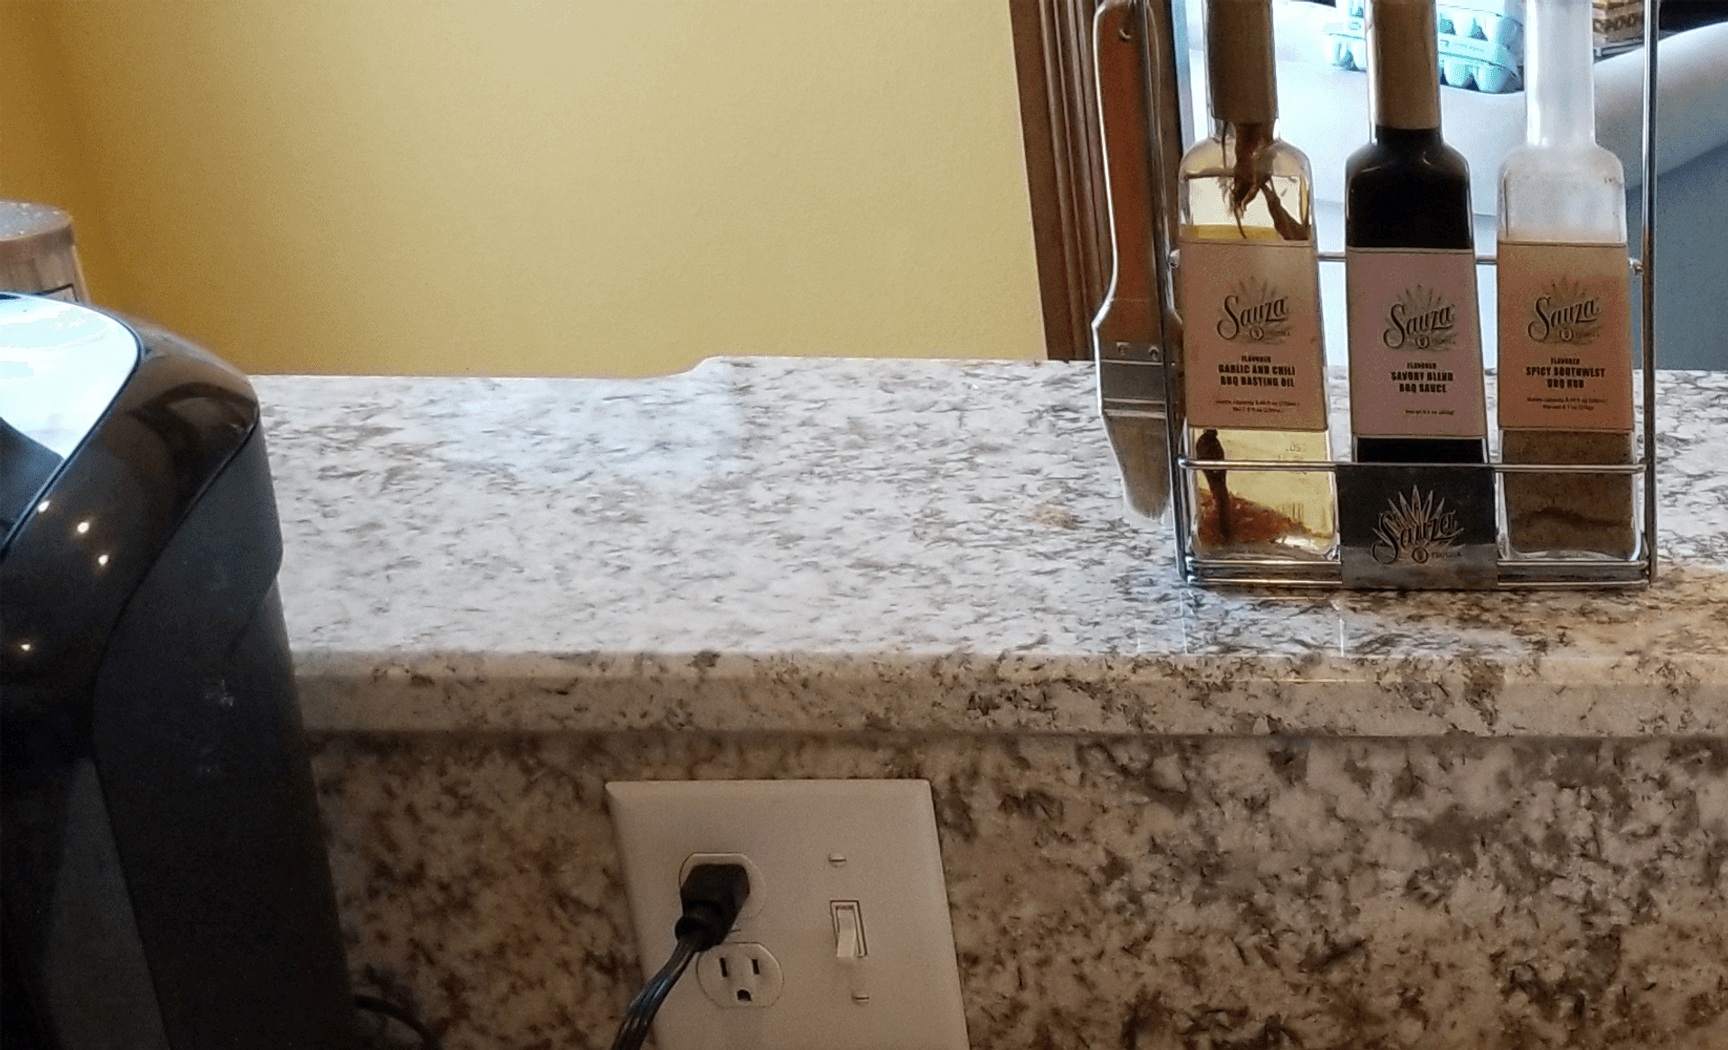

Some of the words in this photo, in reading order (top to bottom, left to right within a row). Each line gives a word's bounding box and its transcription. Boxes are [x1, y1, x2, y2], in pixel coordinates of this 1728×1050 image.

[1217, 294, 1289, 340] Sauza
[1527, 297, 1601, 343] Sauza
[1383, 303, 1455, 349] Sauza
[1218, 364, 1250, 373] GARLIC
[1252, 365, 1270, 374] AND
[1272, 366, 1295, 376] CHILI
[1526, 366, 1551, 376] SPICY
[1554, 367, 1606, 377] SOUTHWEST
[1220, 376, 1239, 386] BBQ
[1241, 376, 1279, 387] BASTING
[1281, 377, 1295, 387] OIL
[1391, 371, 1424, 381] SAVORY
[1427, 372, 1453, 381] BLEND
[1399, 383, 1417, 393] BBQ
[1419, 384, 1447, 393] SAUCE
[1547, 378, 1565, 388] BBQ
[1567, 379, 1584, 389] RUB
[1372, 510, 1456, 565] Sauza
